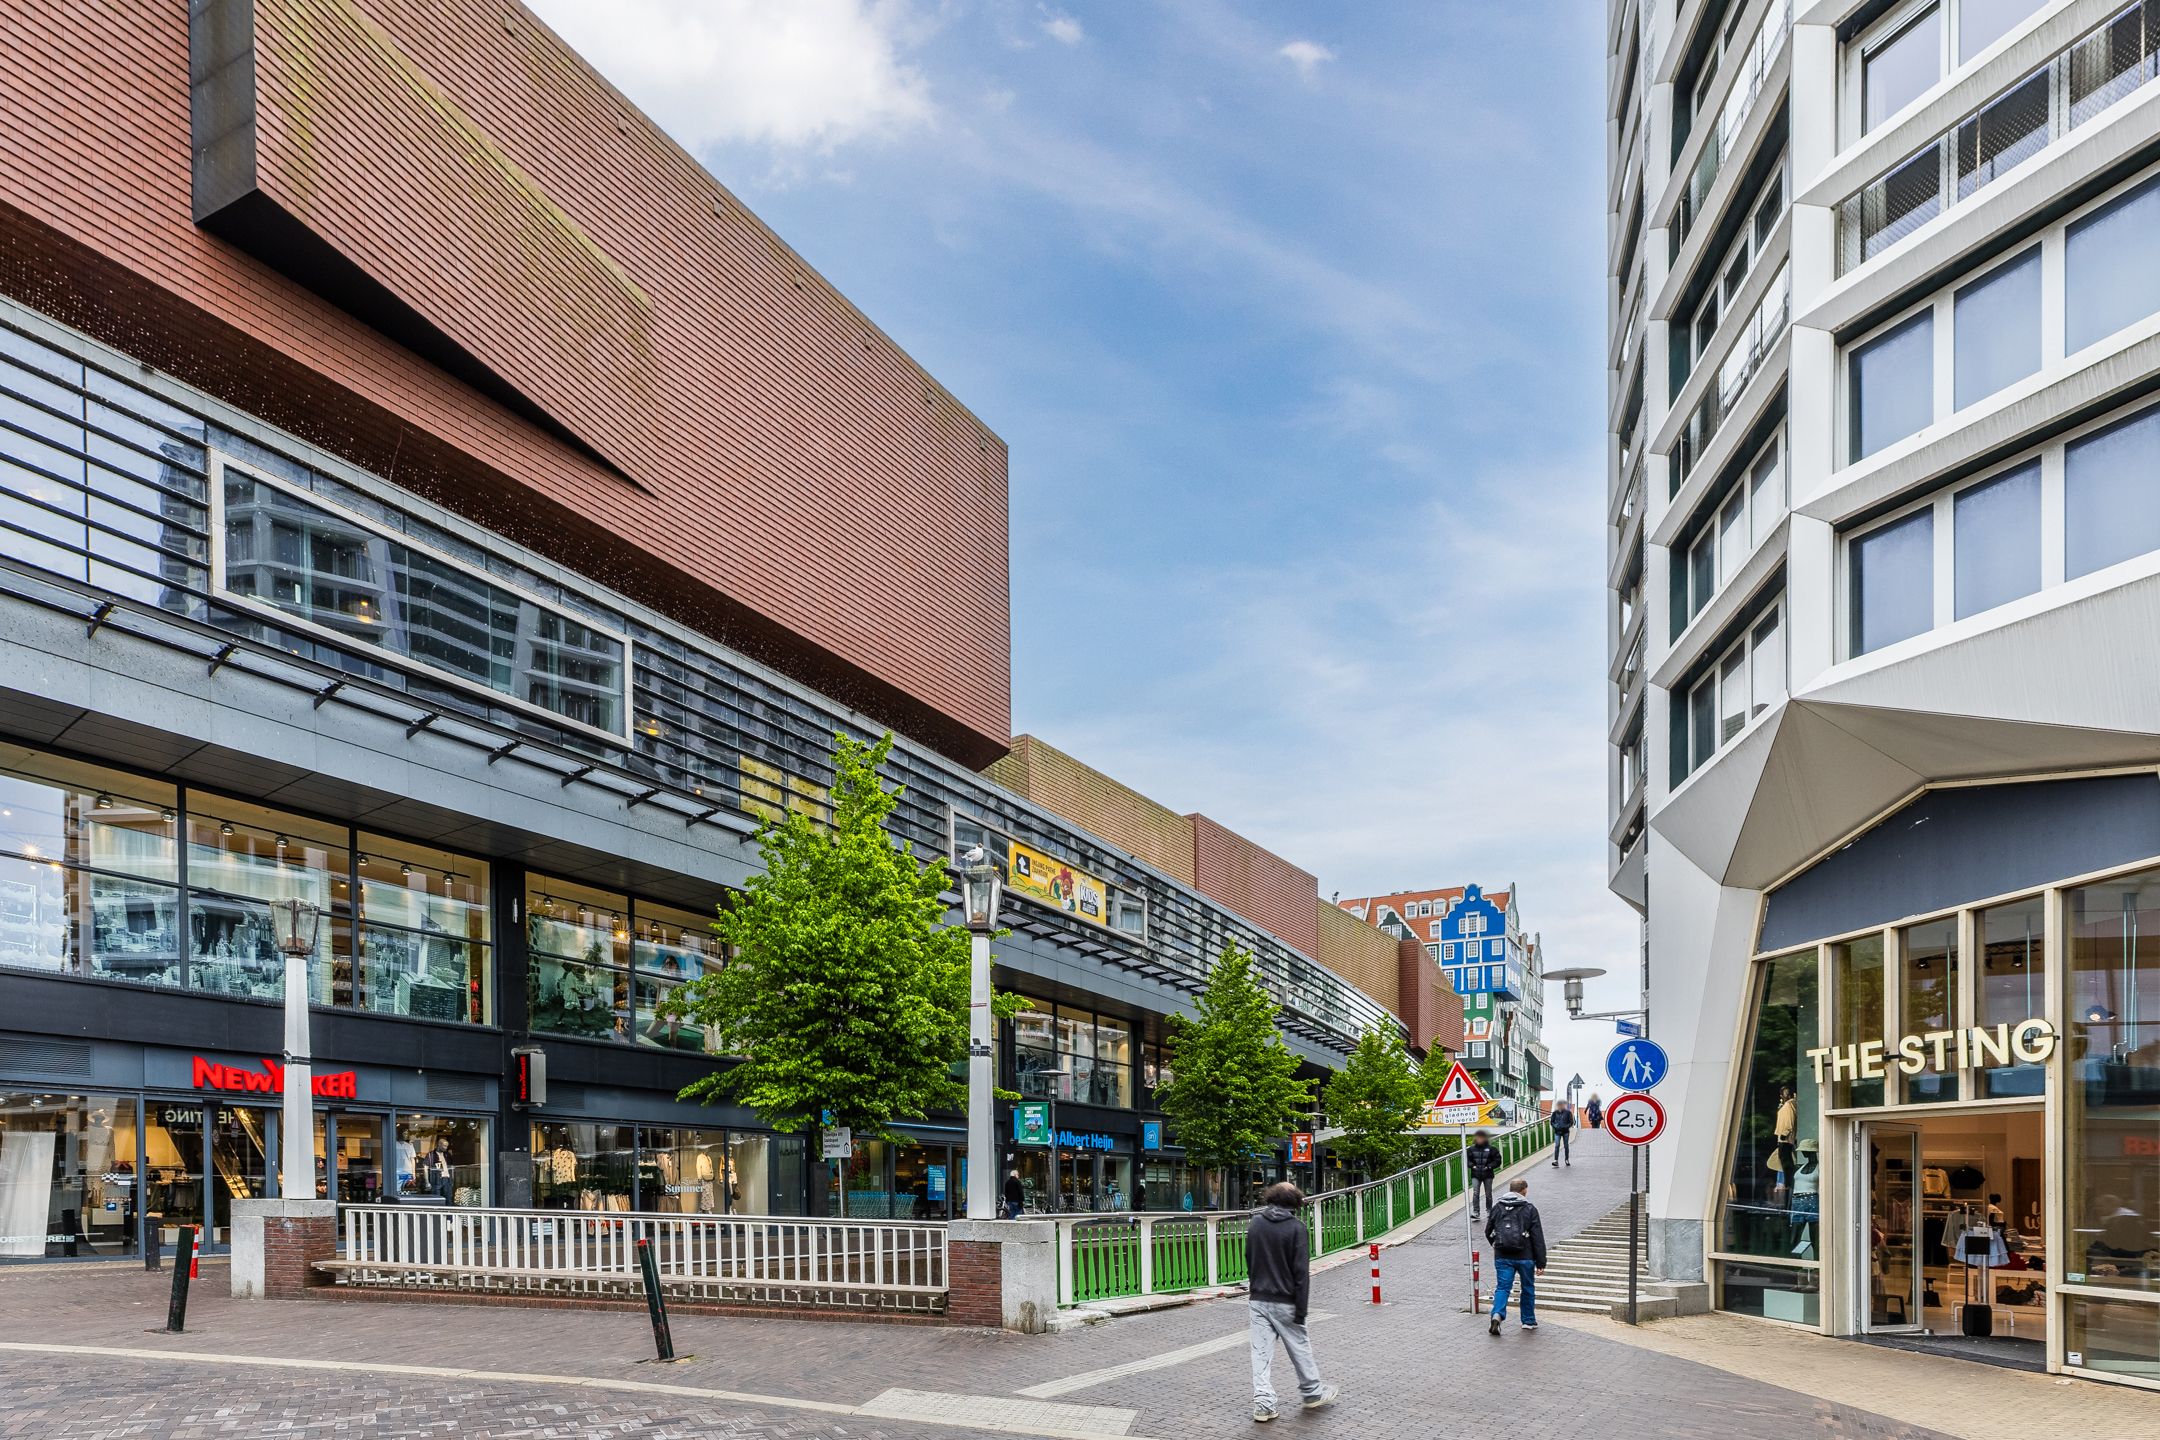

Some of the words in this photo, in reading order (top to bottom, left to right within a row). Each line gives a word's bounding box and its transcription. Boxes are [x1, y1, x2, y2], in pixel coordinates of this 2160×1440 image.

[1806, 1039, 1886, 1084] THE
[1898, 1018, 2055, 1075] STING
[1617, 1109, 1645, 1128] 2,5
[1647, 1116, 1654, 1128] t
[1060, 1131, 1090, 1147] Albert
[1091, 1134, 1114, 1152] Heijn
[665, 1184, 703, 1193] Summer
